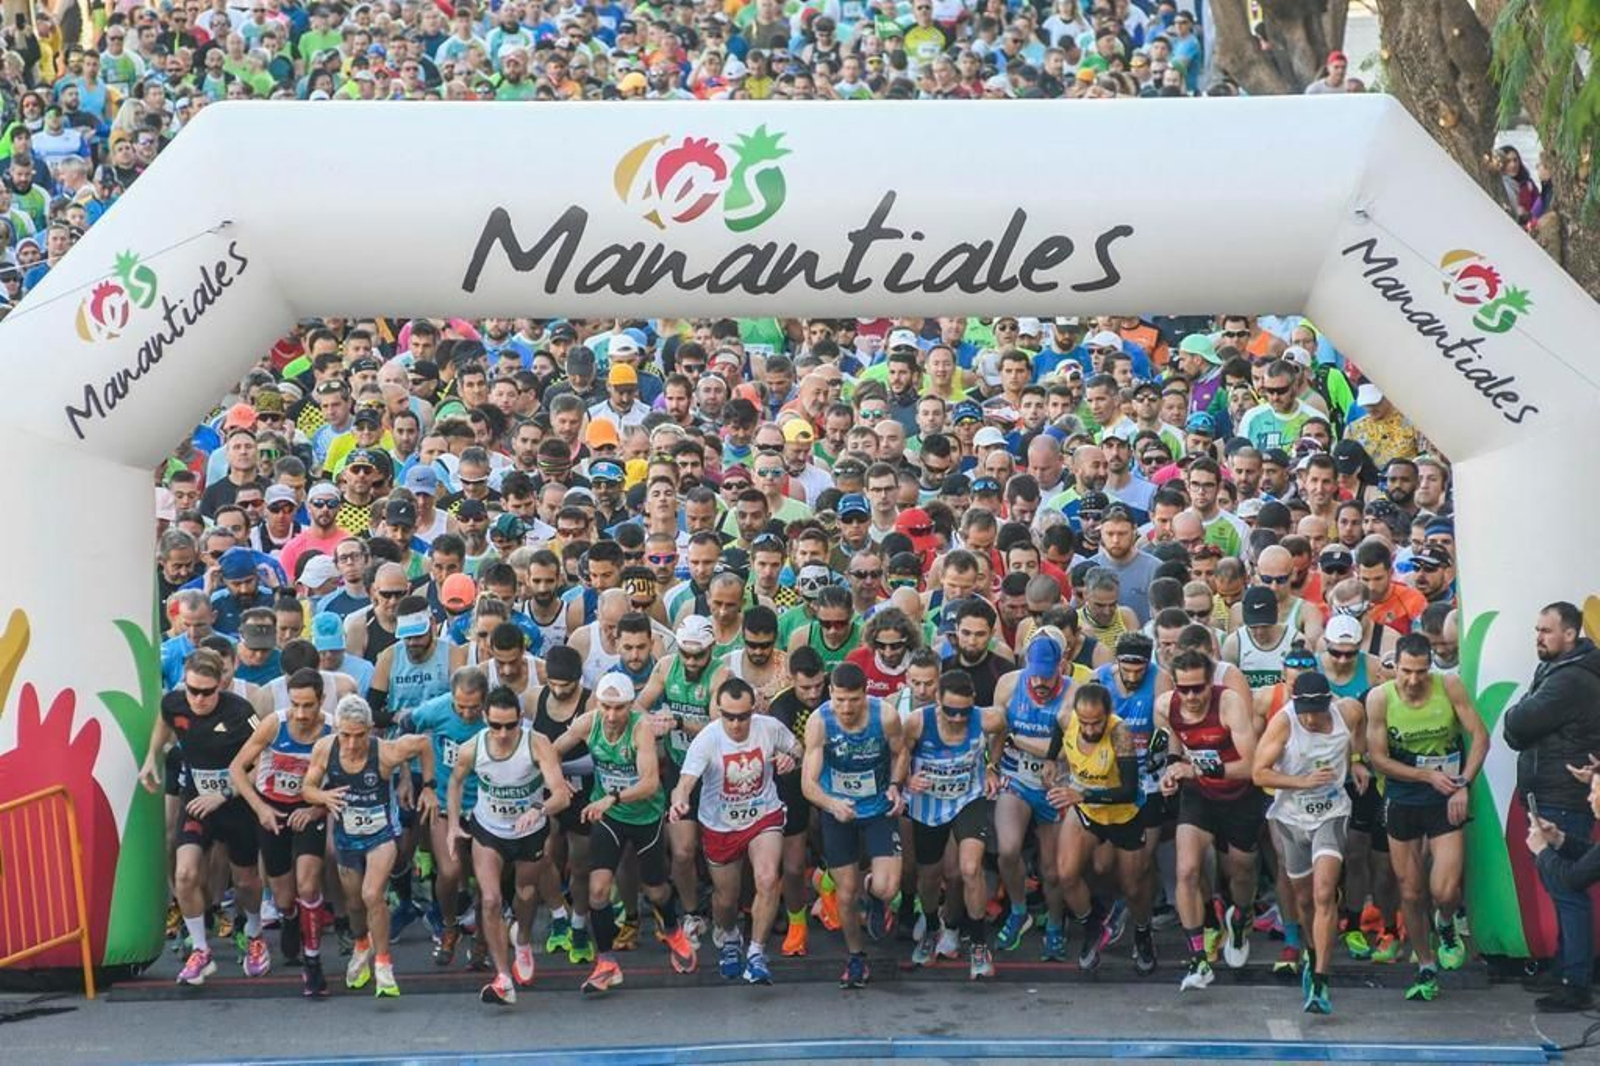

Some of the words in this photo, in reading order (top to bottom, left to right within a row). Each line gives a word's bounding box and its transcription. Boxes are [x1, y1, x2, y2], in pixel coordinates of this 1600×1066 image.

[461, 190, 1134, 295] Manantiales
[1341, 238, 1539, 424] Manantiales
[65, 240, 249, 440] Manantiales
[395, 672, 432, 685] nerja
[201, 778, 228, 791] 589
[842, 780, 862, 790] 63
[931, 782, 966, 793] 1472
[729, 809, 758, 820] 970
